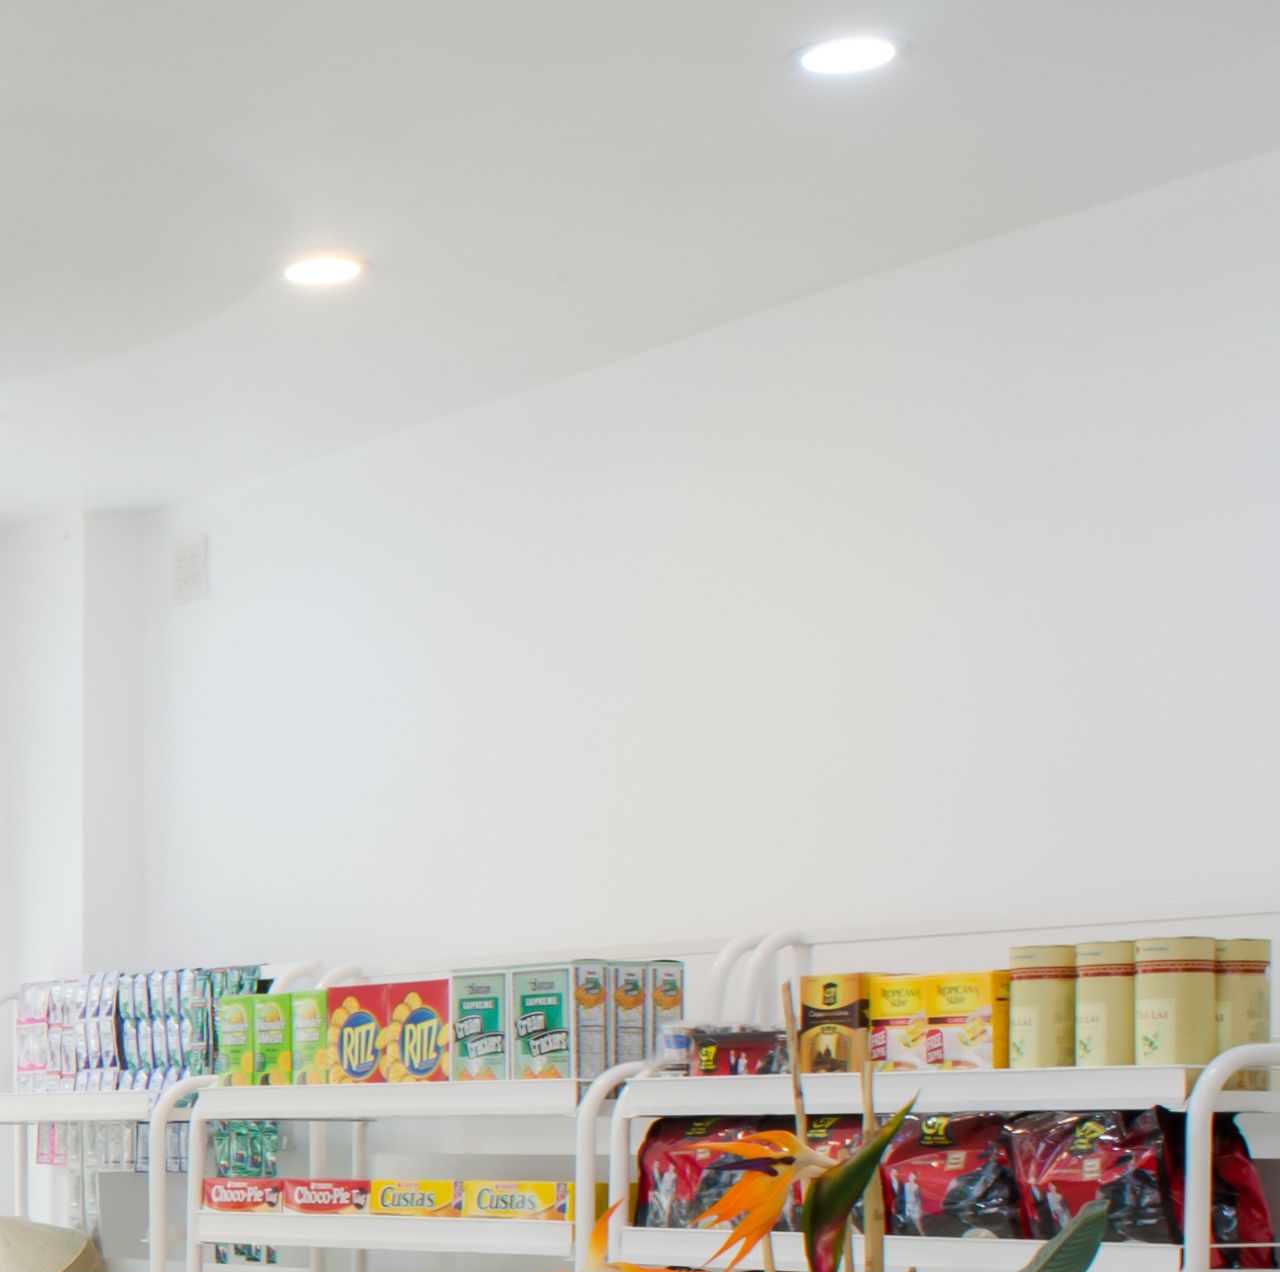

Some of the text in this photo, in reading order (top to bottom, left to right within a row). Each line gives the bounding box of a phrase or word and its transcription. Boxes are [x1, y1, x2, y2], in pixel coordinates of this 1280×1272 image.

[342, 1021, 376, 1071] RITZ
[404, 1018, 438, 1069] RITZ
[380, 1186, 435, 1208] Custas
[476, 1187, 537, 1210] Custas
